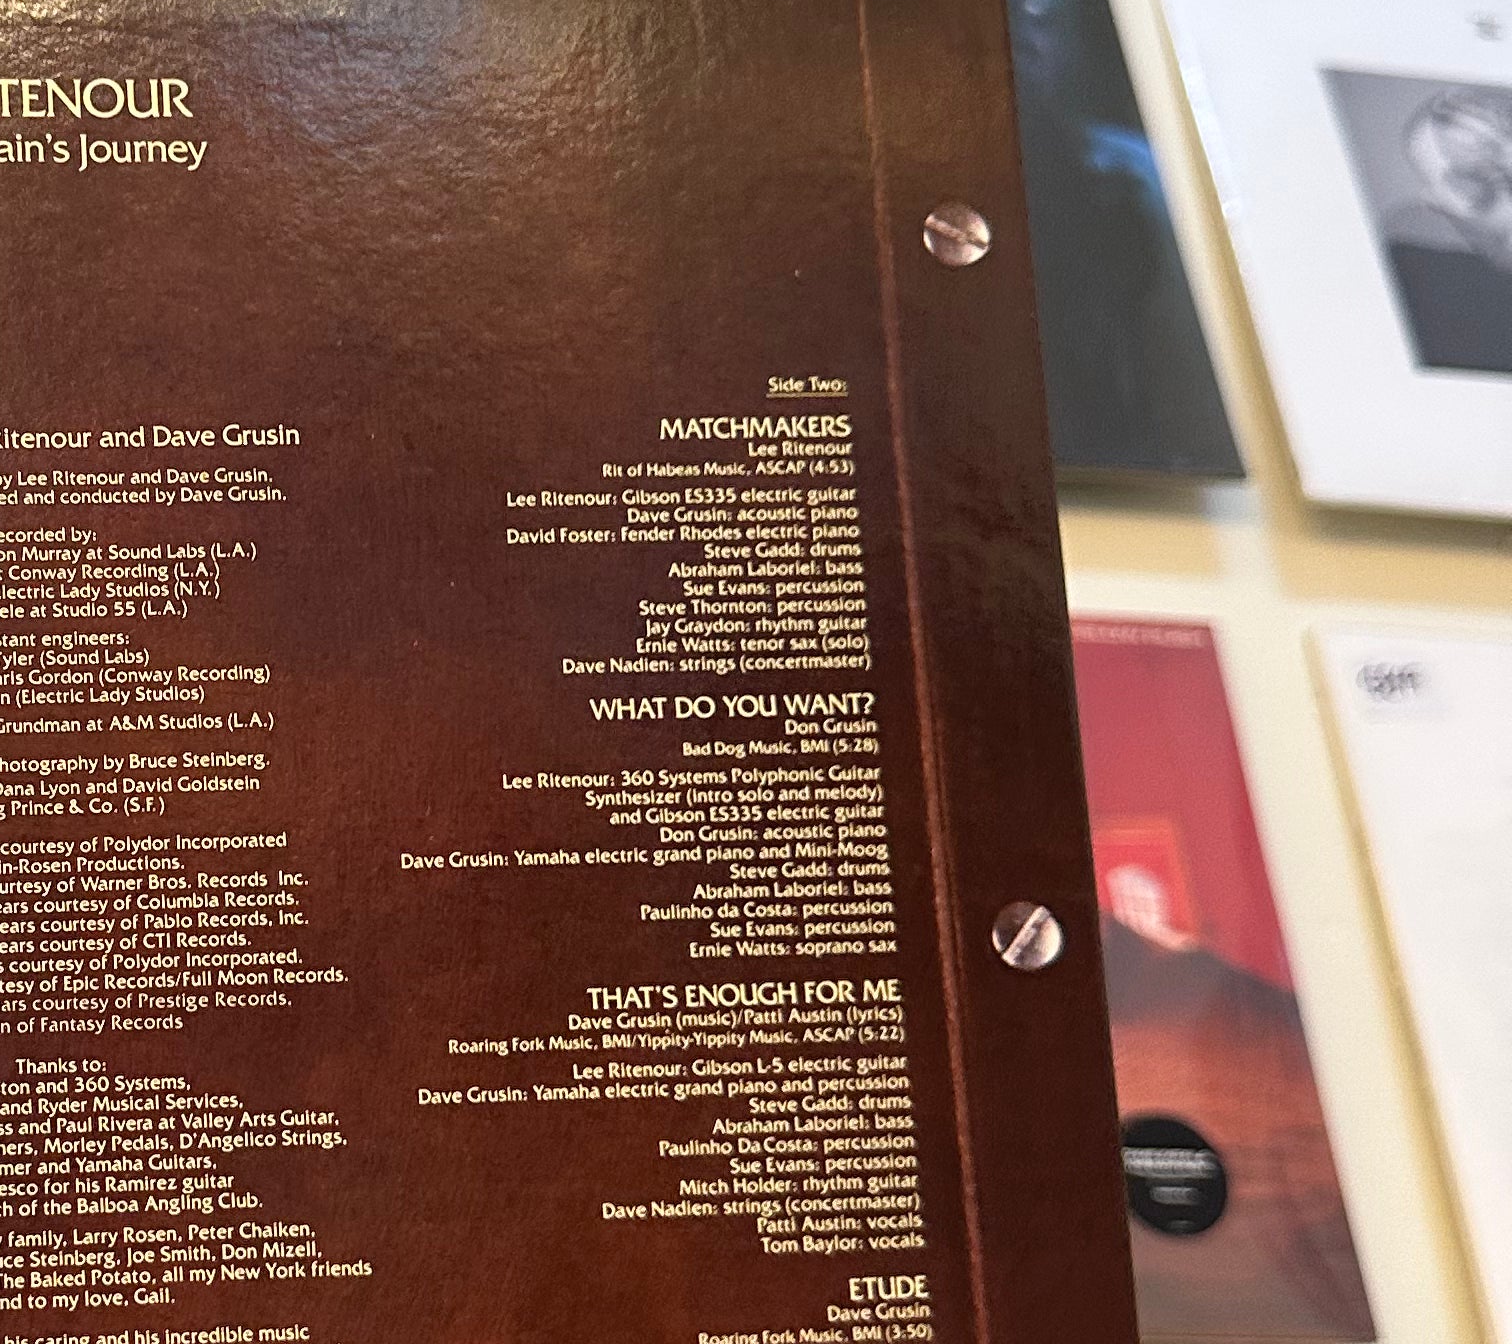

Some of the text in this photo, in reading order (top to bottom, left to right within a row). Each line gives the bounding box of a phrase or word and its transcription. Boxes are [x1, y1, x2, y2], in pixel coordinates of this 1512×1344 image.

[78, 133, 208, 172] Journey
[768, 375, 847, 393] Side Two:
[99, 425, 146, 448] and
[152, 425, 216, 447] Dave
[222, 423, 300, 446] Grusin
[659, 414, 853, 440] MATCHMAKERS
[747, 440, 853, 457] Lee Ritenour
[17, 470, 48, 486] Lee
[52, 470, 125, 486] Ritenour
[130, 468, 162, 485] and
[166, 468, 210, 484] Dave
[213, 467, 273, 484] Grusin.
[70, 526, 97, 546] by:
[41, 630, 130, 651] engineers:
[589, 692, 875, 721] WHAT DO YOU WANT?
[85, 718, 104, 732] at
[109, 714, 155, 731] A&M
[158, 713, 223, 730] Studios
[227, 711, 274, 733] (L.A.)
[784, 718, 878, 735] Don Grusin
[689, 939, 897, 959] Ernie Watts: soprano sax
[586, 978, 902, 1011] THAT'S ENOUGH FOR ME
[14, 1057, 107, 1075] Thanks to:
[35, 1077, 69, 1095] and
[74, 1075, 110, 1093] 360
[114, 1075, 191, 1095] Systems,
[759, 1231, 926, 1255] Tom Baylor: vocals
[848, 1274, 929, 1302] ETUDE
[826, 1301, 931, 1322] Dave Grusin
